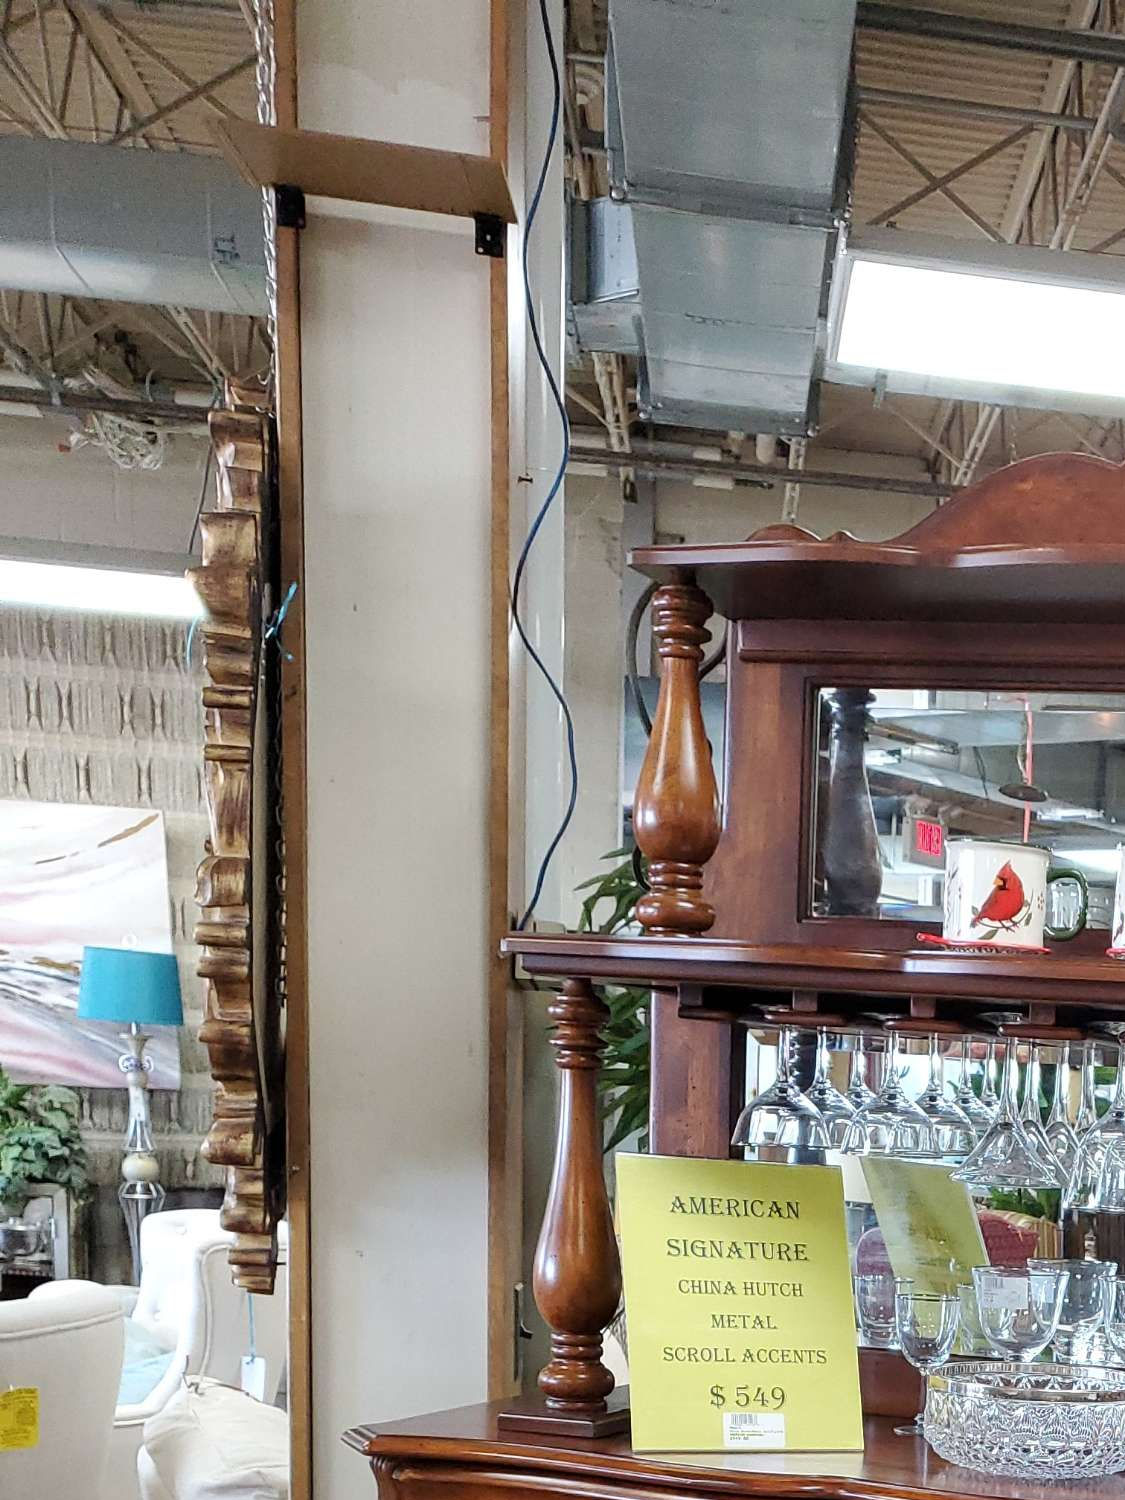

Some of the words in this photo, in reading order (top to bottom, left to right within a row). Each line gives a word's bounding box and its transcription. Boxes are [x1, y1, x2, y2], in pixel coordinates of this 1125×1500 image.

[670, 1196, 800, 1219] AMERICAN
[667, 1238, 809, 1261] SIGNATURE
[678, 1279, 737, 1295] CHINA
[743, 1281, 804, 1297] HUTCH
[711, 1314, 778, 1330] METAL
[663, 1347, 736, 1363] SCROLL
[742, 1348, 827, 1365] ACCENTS
